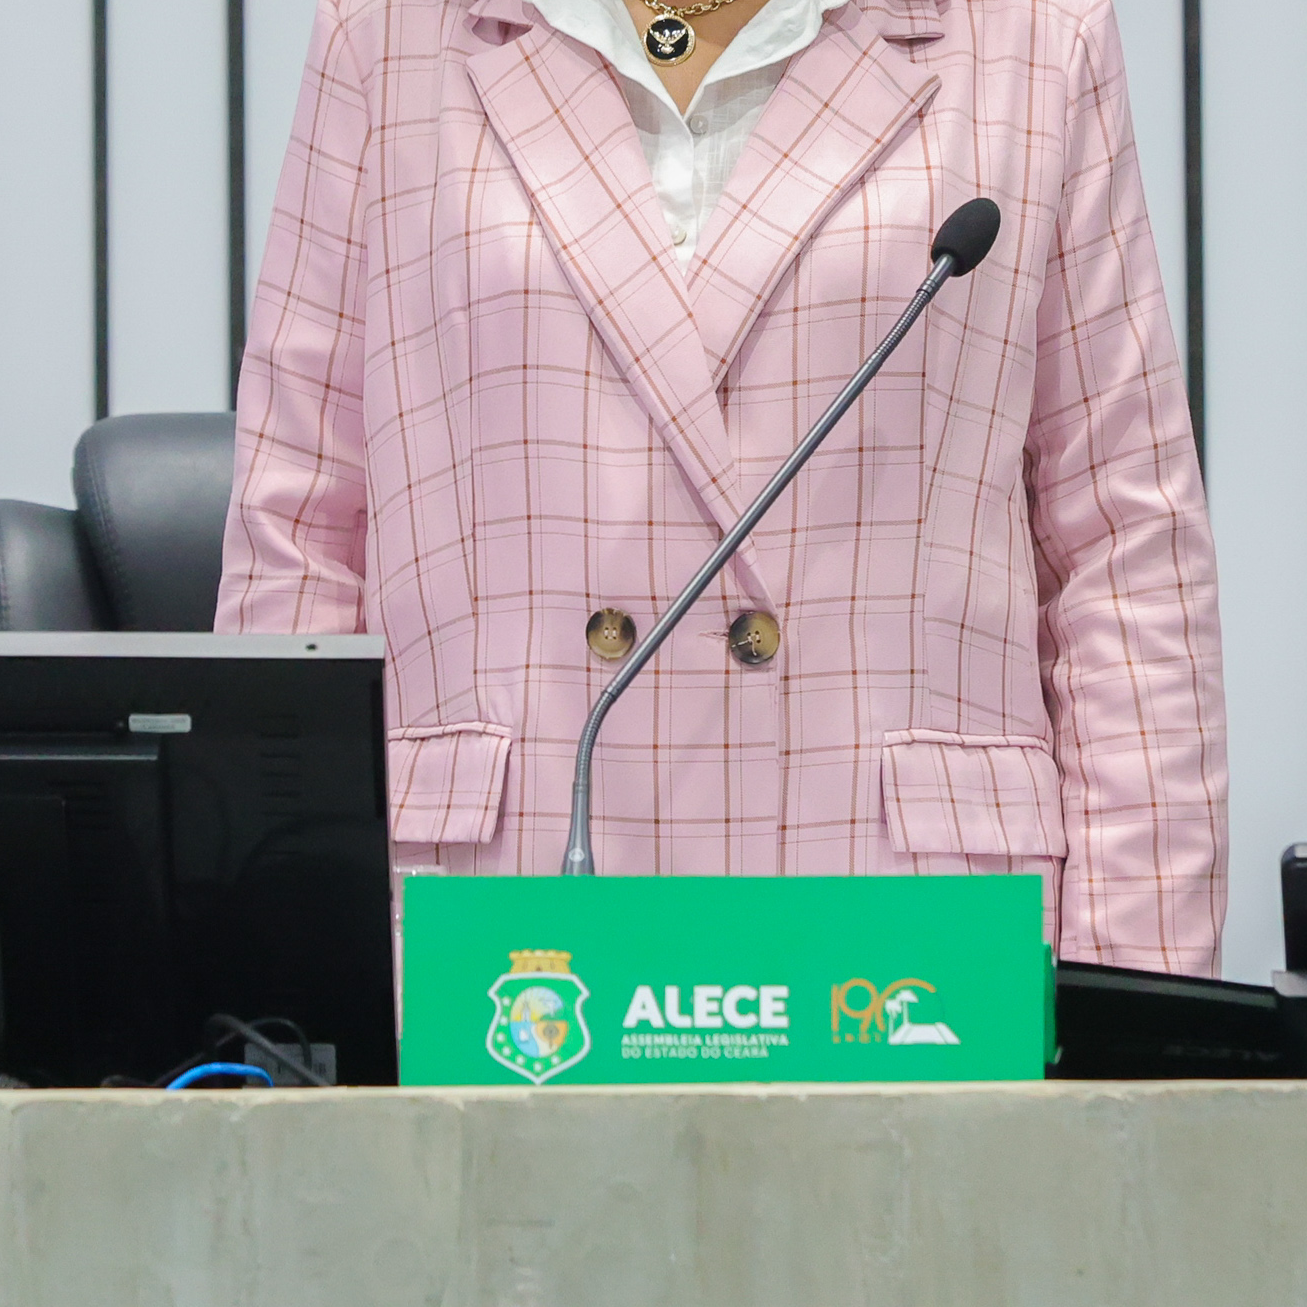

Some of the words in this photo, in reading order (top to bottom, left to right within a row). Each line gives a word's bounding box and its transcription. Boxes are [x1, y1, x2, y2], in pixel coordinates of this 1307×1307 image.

[622, 984, 790, 1029] ALECE
[621, 1033, 703, 1046] ASSEMBLEIA
[705, 1033, 789, 1046] LEGISLATIVA
[621, 1046, 642, 1059] DO
[645, 1046, 698, 1059] ESTADO
[701, 1046, 721, 1059] DO
